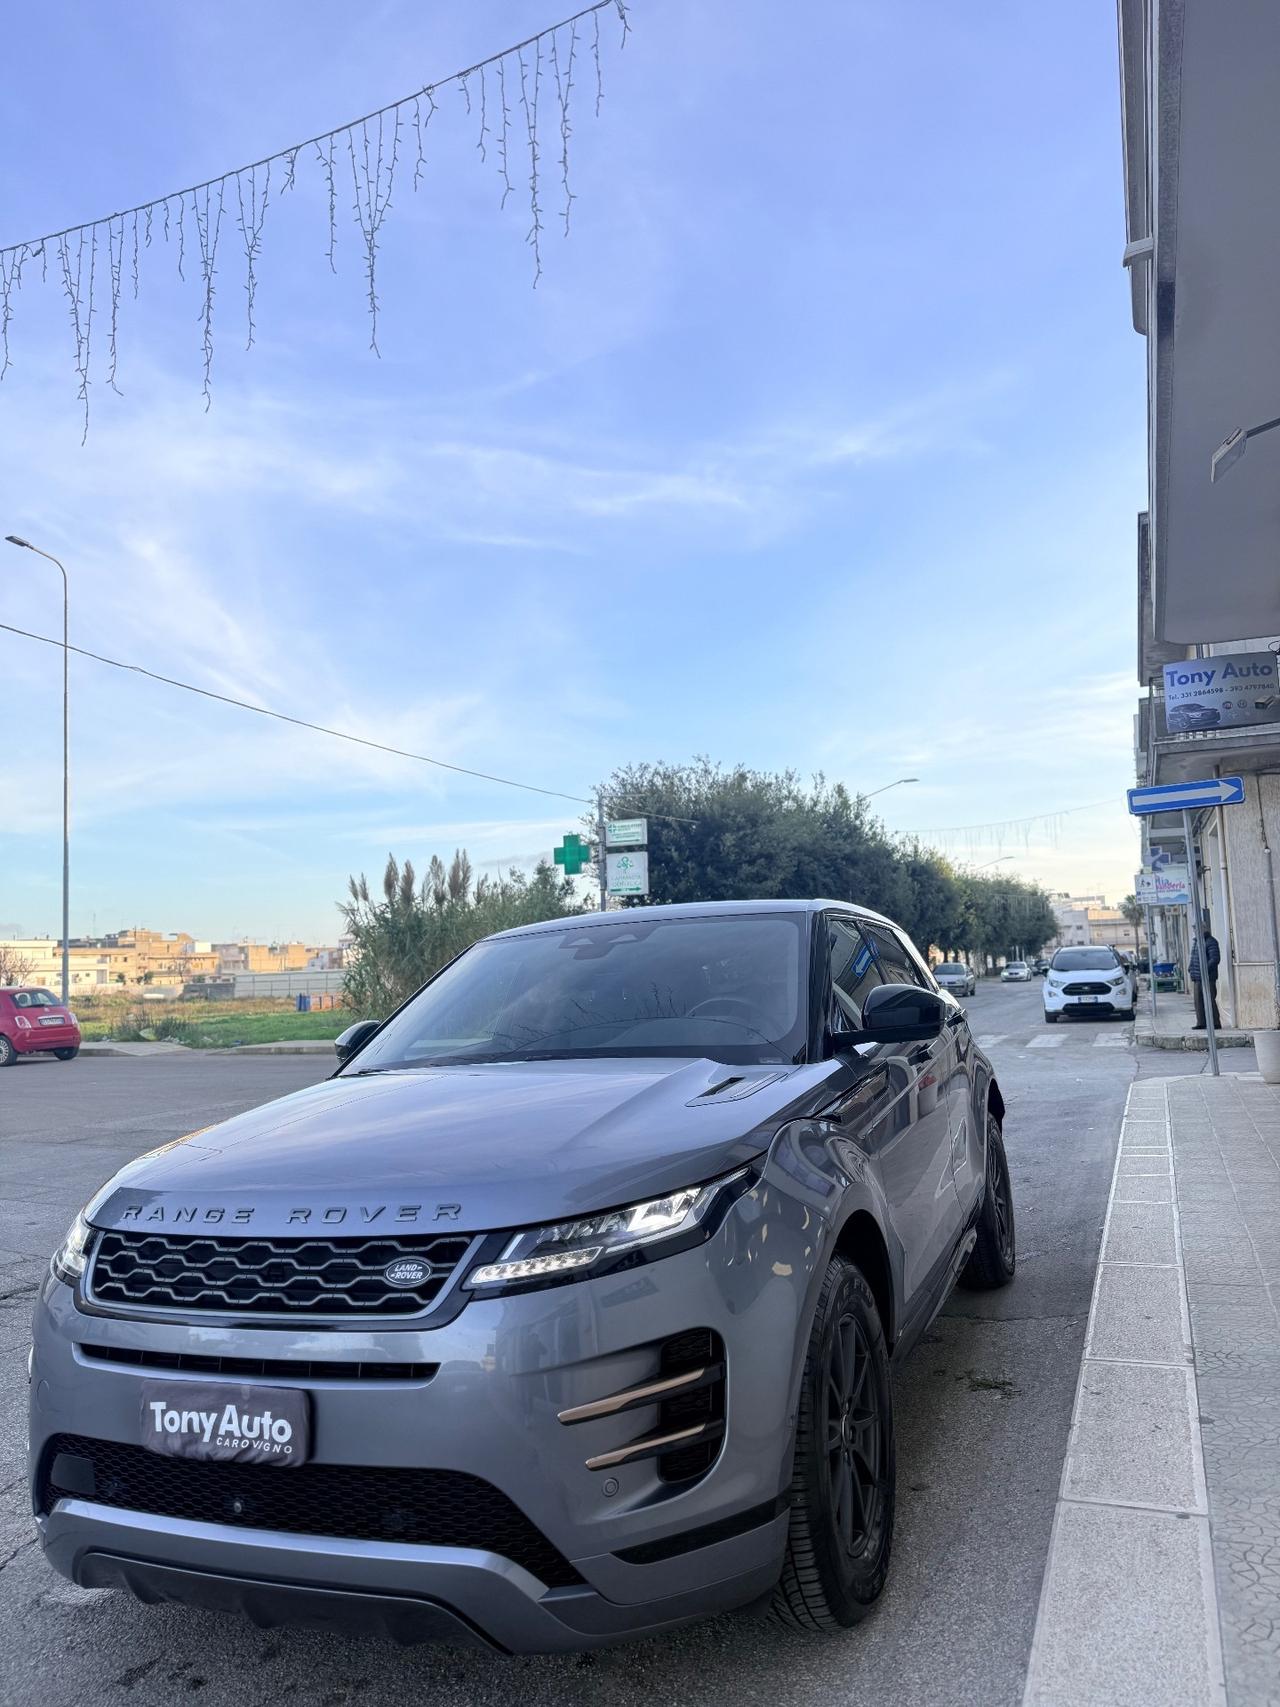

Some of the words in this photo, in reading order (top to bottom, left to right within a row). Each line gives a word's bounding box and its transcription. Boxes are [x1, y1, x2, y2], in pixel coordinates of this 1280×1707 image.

[1166, 670, 1216, 687] Tony
[1222, 662, 1273, 680] Auto
[123, 1205, 255, 1224] RANGE
[285, 1203, 463, 1224] ROVER
[216, 1437, 293, 1455] CAROVIGNO
